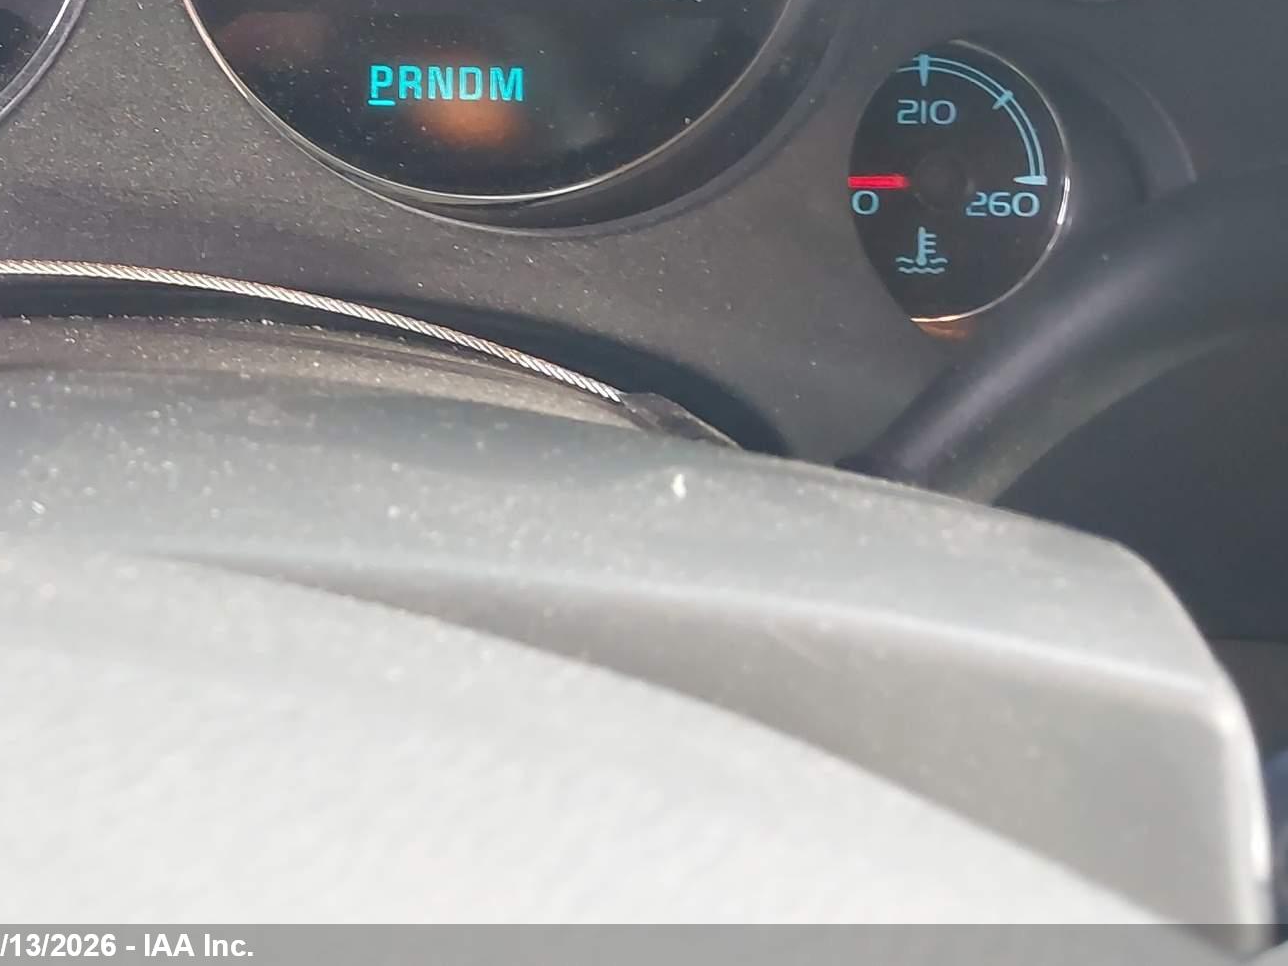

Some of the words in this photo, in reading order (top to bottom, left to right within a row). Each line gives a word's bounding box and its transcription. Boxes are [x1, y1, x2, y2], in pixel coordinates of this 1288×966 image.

[897, 100, 957, 124] 210
[852, 190, 880, 215] 0
[965, 192, 1040, 217] 260
